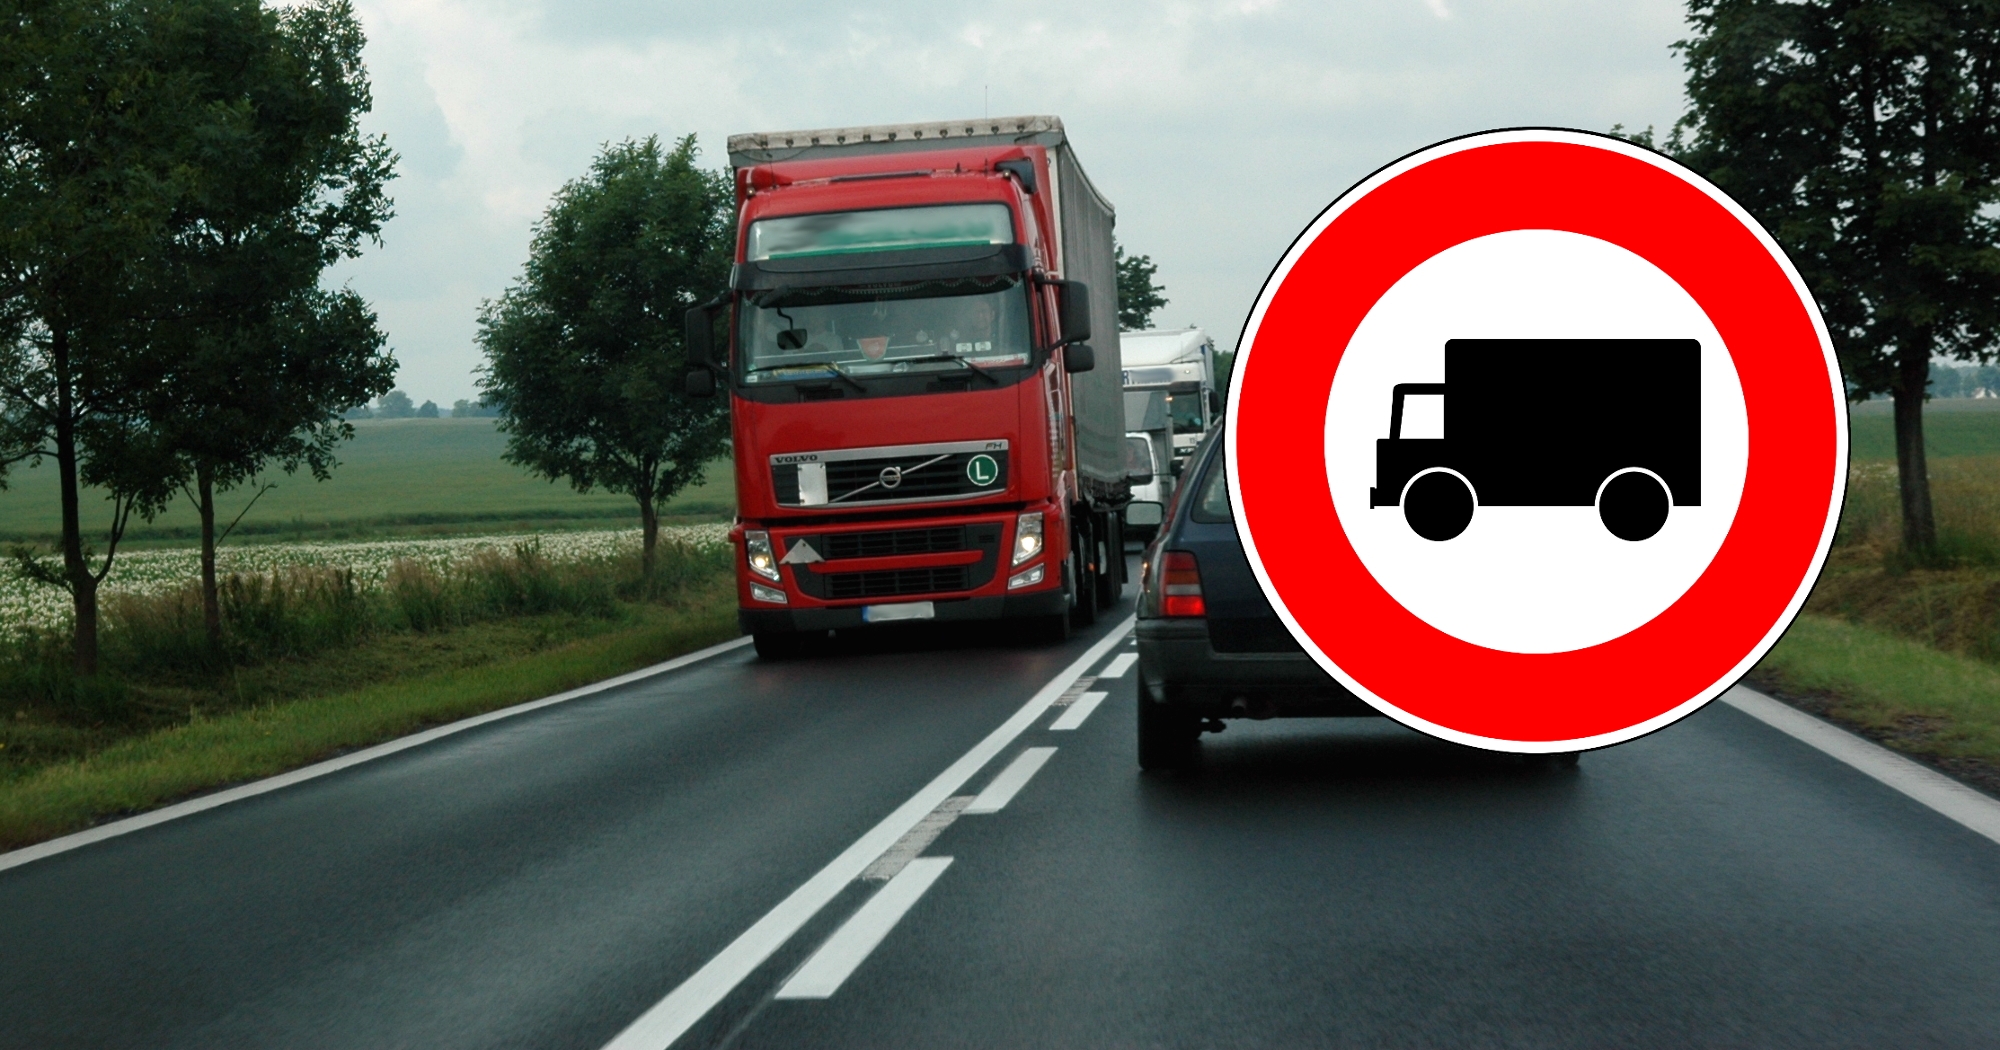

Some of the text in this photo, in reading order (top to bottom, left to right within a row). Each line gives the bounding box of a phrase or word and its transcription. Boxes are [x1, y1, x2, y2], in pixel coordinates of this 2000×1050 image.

[985, 442, 1003, 450] FH
[775, 454, 818, 464] VOLVO
[975, 461, 989, 480] L
